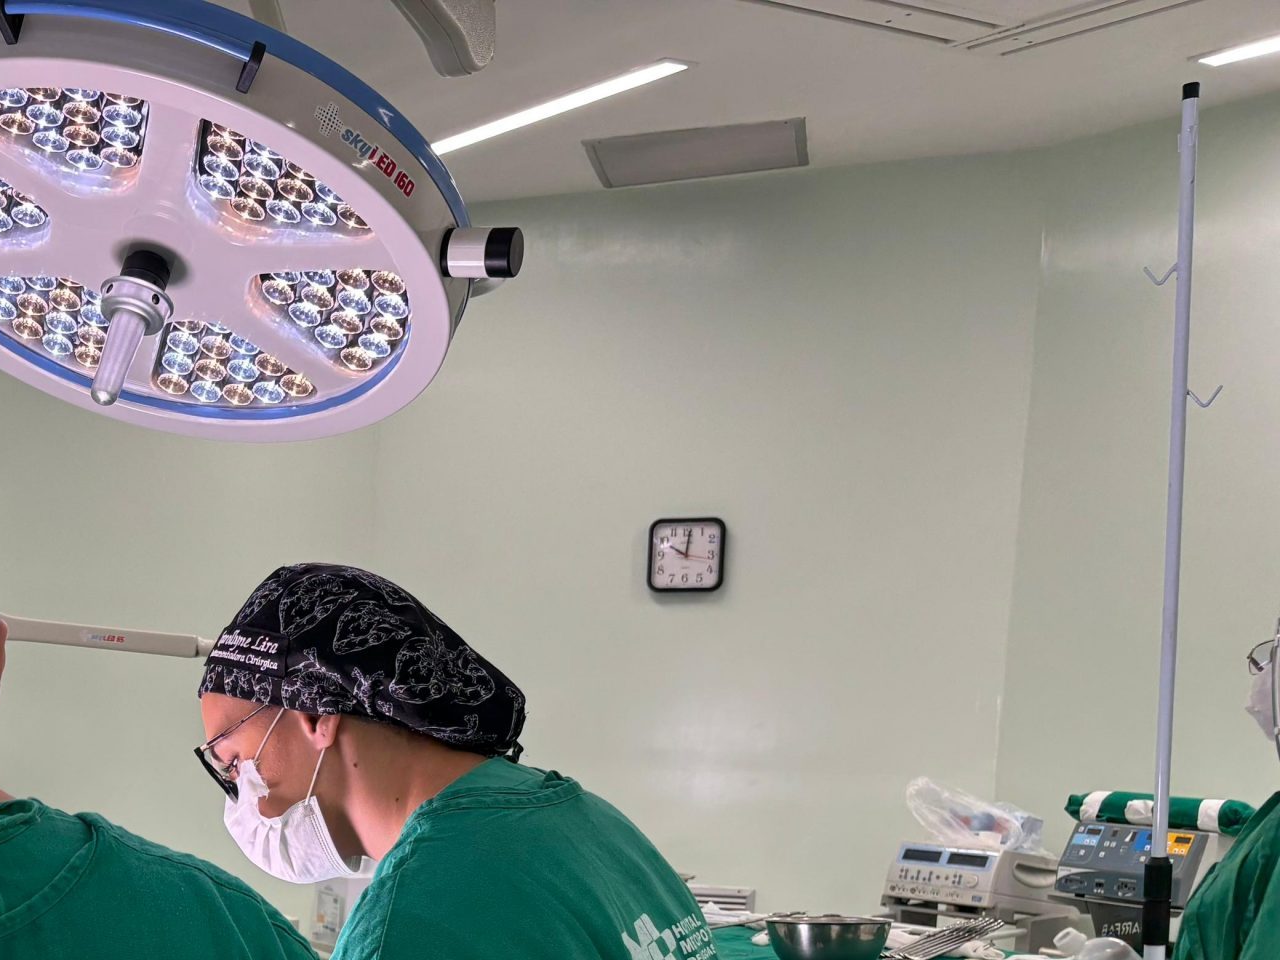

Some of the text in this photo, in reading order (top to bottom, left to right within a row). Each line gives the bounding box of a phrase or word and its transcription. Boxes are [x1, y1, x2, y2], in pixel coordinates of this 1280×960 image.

[341, 128, 415, 197] skyLED 160
[708, 534, 716, 544] 2
[657, 551, 665, 560] 9
[708, 550, 715, 560] 3
[657, 565, 664, 575] 8
[669, 574, 675, 583] 7
[681, 573, 688, 583] 6
[695, 573, 703, 583] 5
[251, 635, 279, 654] Lira
[245, 653, 278, 671] Cirúrgica
